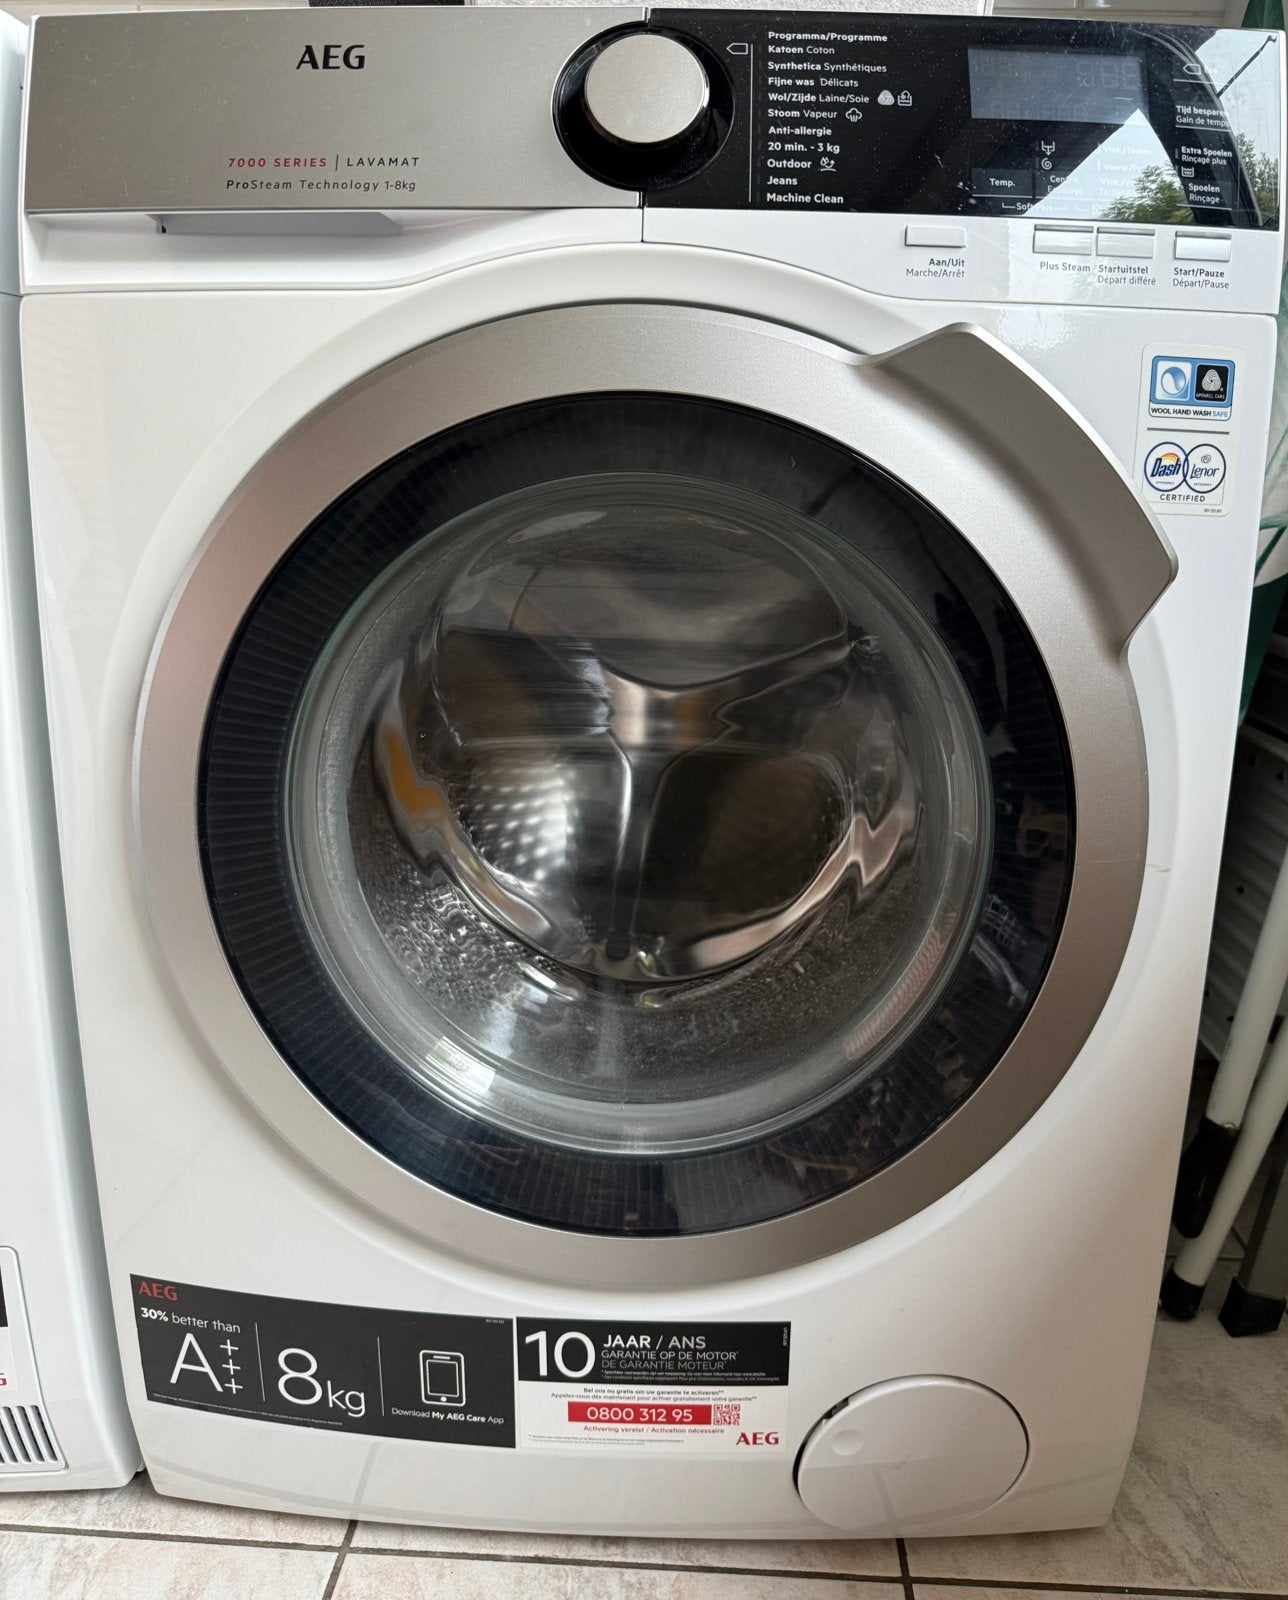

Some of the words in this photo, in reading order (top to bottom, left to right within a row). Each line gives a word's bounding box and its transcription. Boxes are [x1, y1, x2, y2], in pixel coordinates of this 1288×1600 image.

[768, 31, 888, 42] Programma/Programme
[768, 45, 804, 54] Katoen
[806, 46, 835, 55] Coton
[296, 45, 366, 70] AEG
[768, 61, 822, 73] Synthetica
[824, 62, 888, 73] Synthétiques
[768, 77, 793, 88] Fijne
[795, 78, 815, 87] was
[820, 78, 859, 88] Délicats
[768, 92, 817, 103] Wol/Zijde
[819, 93, 870, 104] Laine/Soie
[768, 108, 800, 118] Stoom
[803, 109, 838, 120] Vapeur
[1176, 105, 1192, 115] Tijd
[1176, 115, 1194, 125] Gain
[1195, 117, 1205, 126] de
[1206, 117, 1230, 128] temps
[768, 126, 832, 138] Anti-allergie
[767, 141, 782, 152] 20
[784, 142, 808, 152] min.
[817, 143, 824, 152] 3
[826, 142, 840, 155] kg
[1181, 146, 1202, 156] Extra
[1203, 147, 1233, 159] Spoelen
[228, 158, 267, 169] 7000
[273, 157, 328, 168] SERIES
[346, 157, 421, 168] LAVAMAT
[767, 159, 812, 169] Outdoor
[1181, 154, 1211, 166] Rinçage
[1211, 156, 1227, 166] plus
[226, 180, 292, 190] ProSteam
[300, 179, 379, 192] Technology
[385, 180, 416, 192] 1-8kg
[767, 175, 798, 186] Jeans
[988, 177, 1016, 188] Temp.
[1188, 182, 1221, 194] Spoelen
[767, 192, 811, 204] Machine
[814, 193, 844, 204] Clean
[1188, 193, 1221, 206] Rinçage
[928, 257, 965, 268] Aan/Uit
[1040, 261, 1059, 272] Plus
[1062, 262, 1091, 273] Steam
[906, 268, 965, 279] Marche/Arrêt
[1098, 265, 1149, 275] Startuitstel
[1173, 268, 1225, 279] Start/Pauze
[1097, 275, 1127, 287] Départ
[1129, 276, 1157, 287] différé
[1172, 279, 1230, 291] Départ/Pause
[1151, 407, 1171, 415] WOOL
[1150, 457, 1182, 478] Dash
[1190, 463, 1220, 479] Lenor
[1160, 494, 1206, 503] CERTIFIED
[139, 1281, 178, 1301] AEG
[141, 1307, 169, 1323] 30%
[172, 1312, 209, 1329] better
[212, 1319, 241, 1334] than
[603, 1334, 651, 1349] JAAR
[669, 1336, 707, 1349] ANS
[525, 1330, 596, 1378] 10
[601, 1350, 657, 1361] GARANTIE
[659, 1351, 676, 1360] OP
[679, 1351, 694, 1360] DE
[601, 1359, 617, 1369] DE
[619, 1360, 675, 1370] GARANTIE
[616, 1388, 634, 1396] gratis
[656, 1389, 682, 1397] garantie
[391, 1407, 431, 1419] Download
[431, 1411, 444, 1423] My
[446, 1411, 465, 1422] AEG
[466, 1413, 486, 1423] Care
[487, 1414, 505, 1426] App
[586, 1406, 634, 1421] 0800
[639, 1407, 667, 1422] 312
[672, 1408, 693, 1422] 95
[583, 1424, 619, 1434] Activering
[621, 1426, 645, 1434] vereist
[651, 1426, 687, 1435] Activation
[688, 1426, 725, 1435] nécessaire
[735, 1431, 780, 1446] AEG
